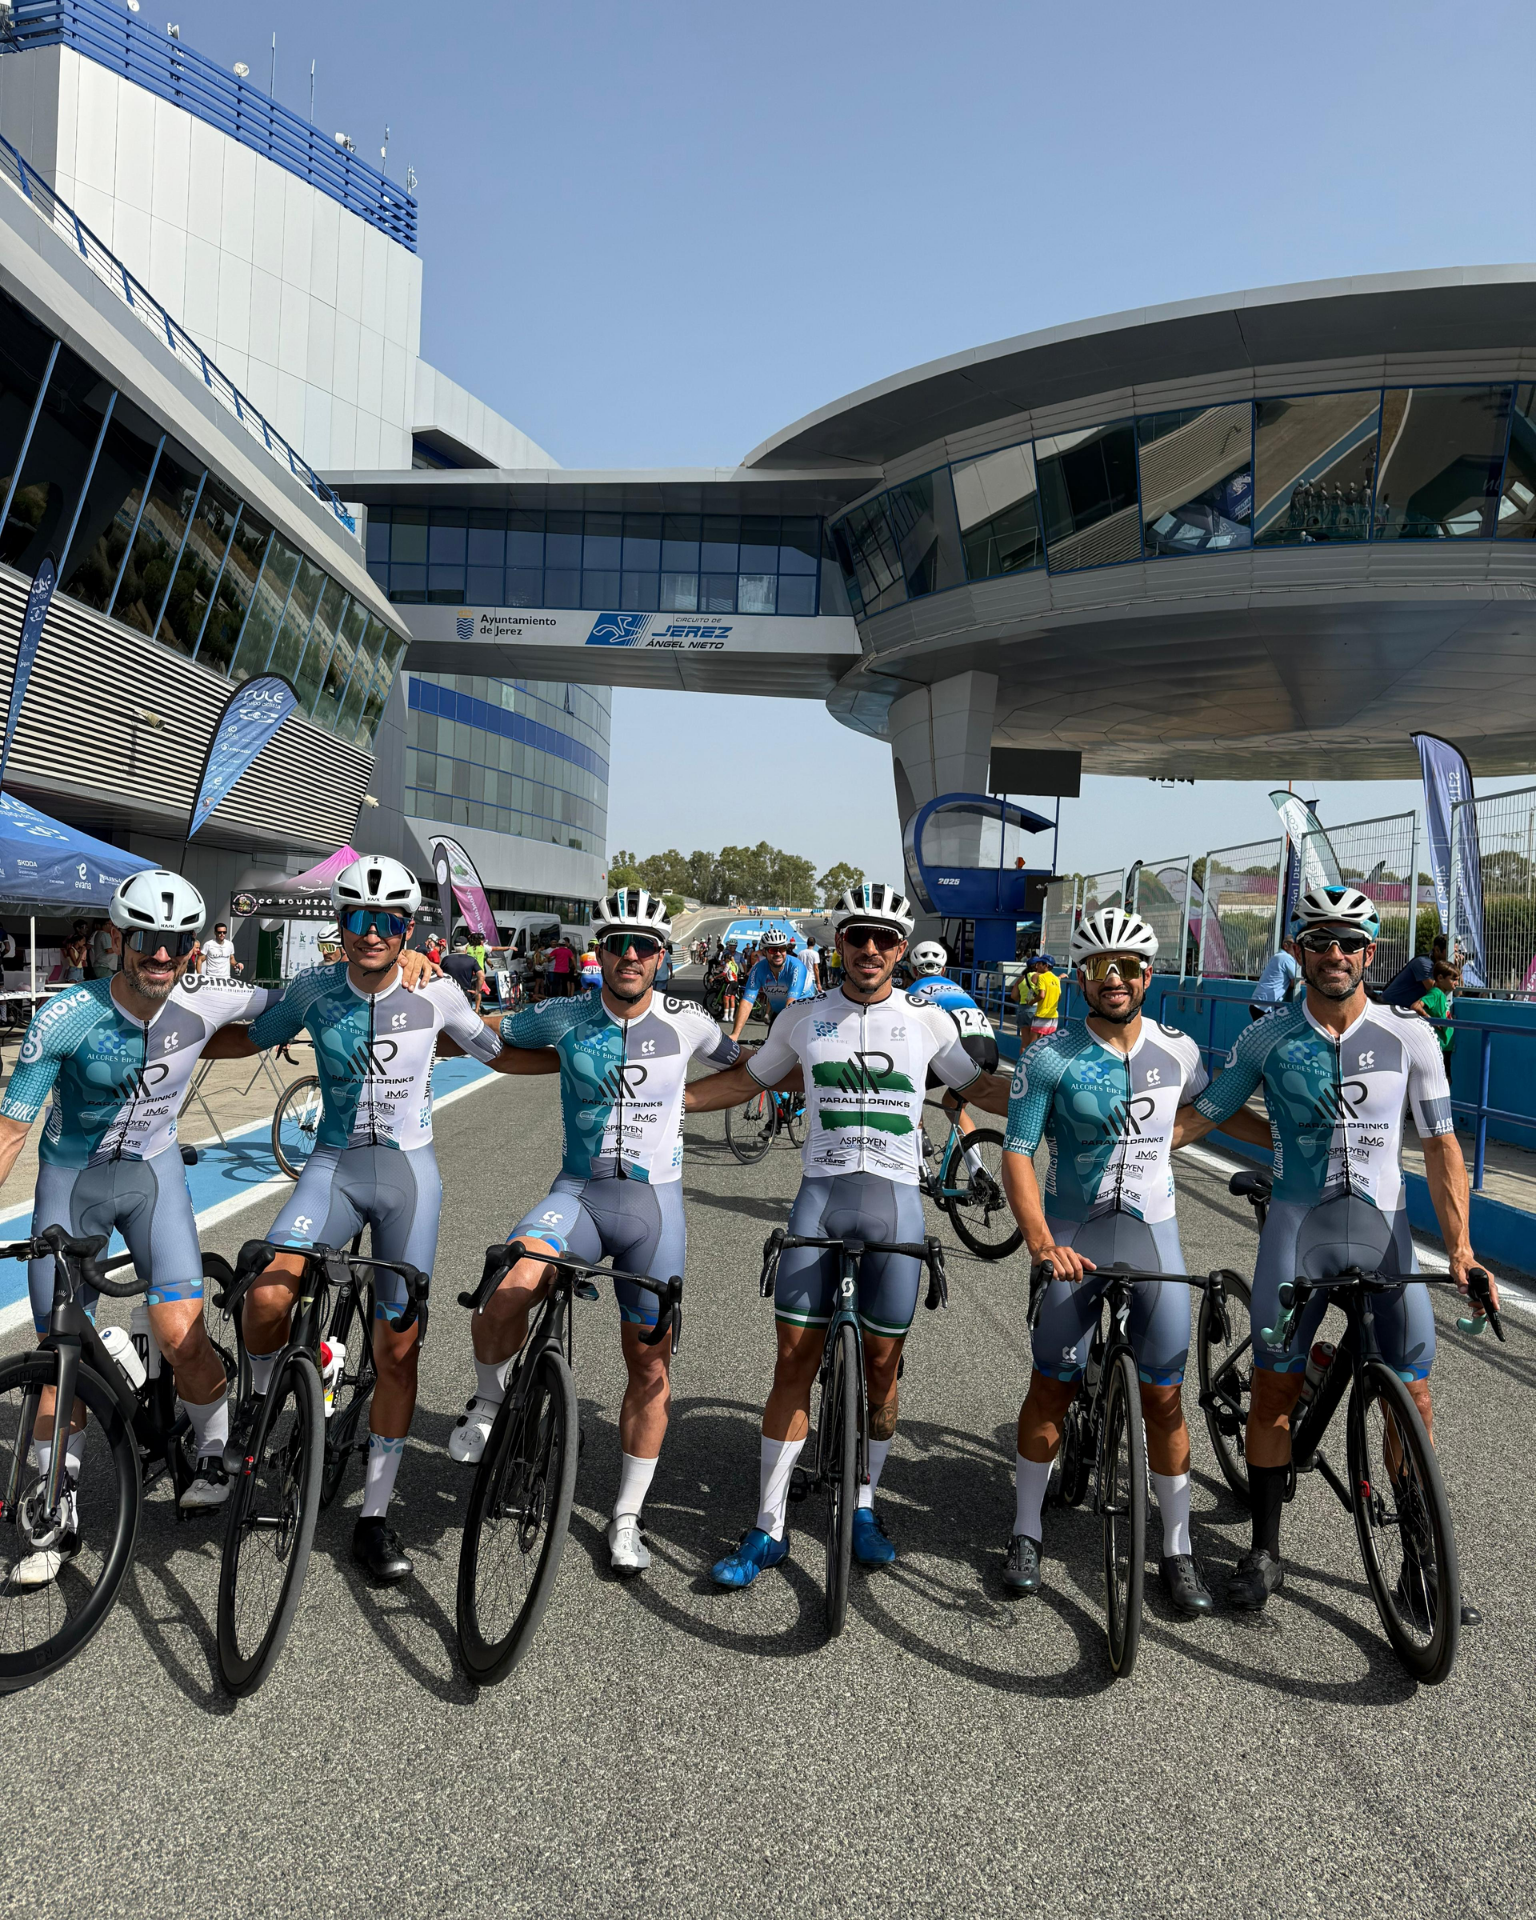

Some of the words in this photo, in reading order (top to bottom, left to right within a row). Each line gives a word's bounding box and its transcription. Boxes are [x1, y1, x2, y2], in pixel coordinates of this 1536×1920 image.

[480, 613, 557, 627] Ayuntamiento
[480, 625, 494, 635] de
[495, 627, 523, 637] Jerez
[651, 625, 733, 639] JEREZ
[645, 638, 686, 649] ÁNGEL
[687, 641, 725, 650] NIETO
[75, 881, 92, 890] evaria
[937, 877, 961, 885] 2025
[279, 898, 333, 906] MOUNTAI
[298, 909, 336, 917] JEREZ
[317, 1017, 347, 1032] ALCORES
[350, 1028, 367, 1036] BIKE
[87, 1053, 118, 1062] ALCORES
[572, 1042, 601, 1057] ALCORES
[603, 1052, 618, 1061] BIKE
[1279, 1063, 1311, 1073] ALCORES
[1314, 1069, 1332, 1077] BIKE
[1070, 1083, 1103, 1092] ALCORES
[1106, 1087, 1124, 1095] BIKE
[8, 1101, 38, 1121] BIKE
[45, 1107, 63, 1146] ALCORES
[1271, 1118, 1279, 1142] BIKE
[839, 1136, 887, 1147] ASPROYEN
[1050, 1135, 1058, 1160] BIKE
[1273, 1142, 1284, 1180] ALCORES
